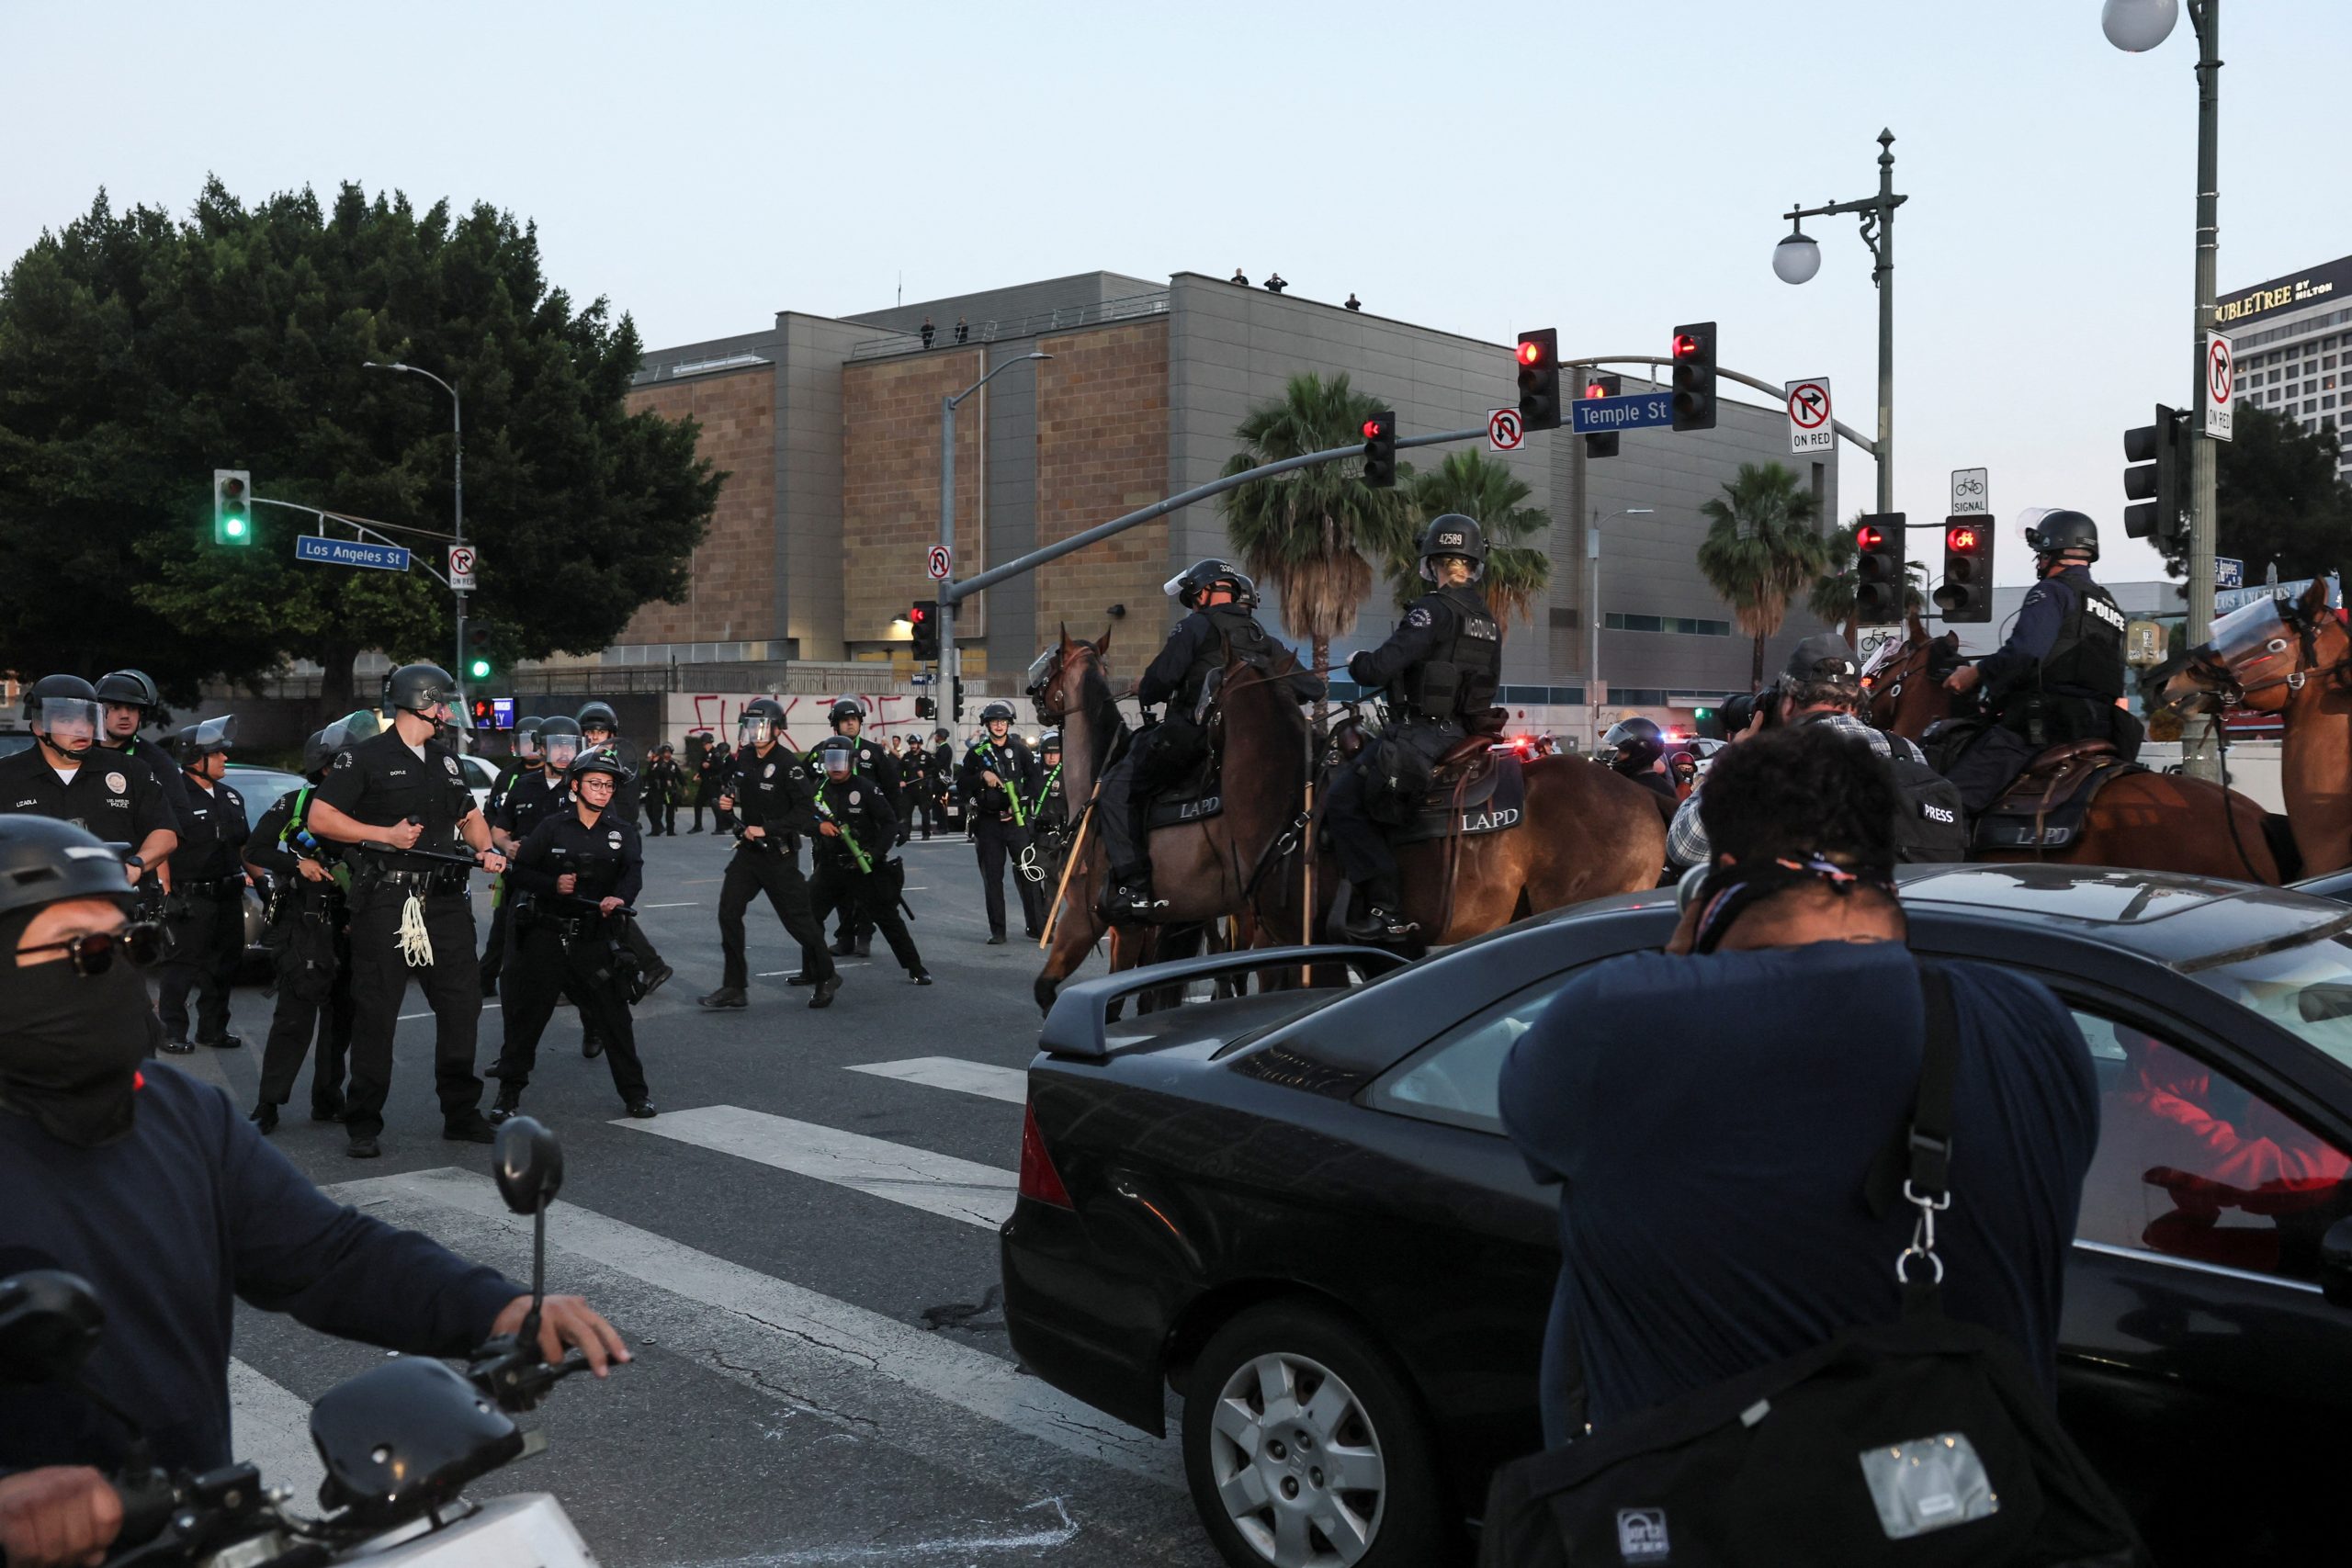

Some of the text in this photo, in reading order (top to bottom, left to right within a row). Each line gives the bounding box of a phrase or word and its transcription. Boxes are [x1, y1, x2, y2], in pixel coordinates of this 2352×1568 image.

[2296, 279, 2310, 291] BY
[2296, 282, 2333, 300] HILTON
[1581, 401, 1667, 425] Temple St
[2210, 409, 2230, 429] ON RED
[1794, 433, 1830, 446] ON RED
[1954, 501, 1985, 513] SIGNAL
[1439, 534, 1463, 545] 42589
[306, 542, 401, 565] Los Angeles St
[2086, 597, 2124, 632] POLICE
[1180, 796, 1219, 818] LAPD
[1924, 804, 1954, 823] PRESS
[1462, 808, 1520, 831] LAPD
[2016, 827, 2070, 844] LPD
